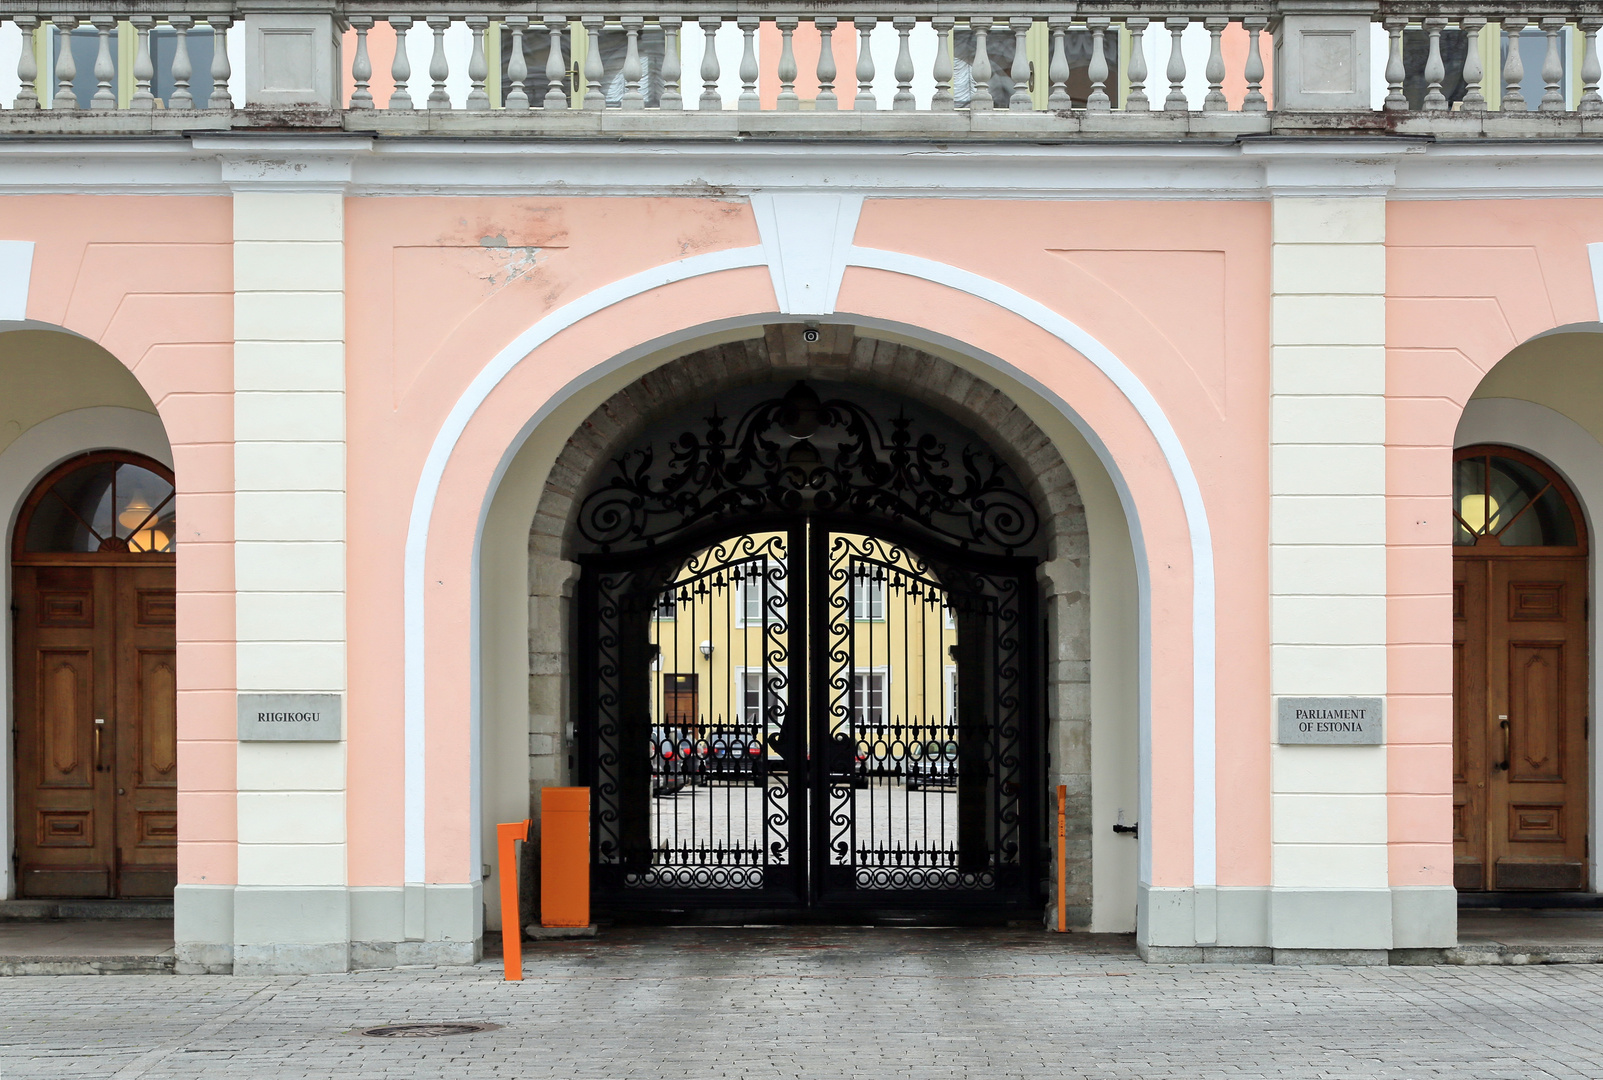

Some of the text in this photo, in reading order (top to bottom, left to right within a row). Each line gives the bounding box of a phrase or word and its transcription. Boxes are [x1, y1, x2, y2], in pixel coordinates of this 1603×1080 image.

[258, 712, 320, 722] RIIGIKOGU
[1296, 709, 1366, 719] PARLIAMENT
[1299, 722, 1363, 732] OF ESTONIA
